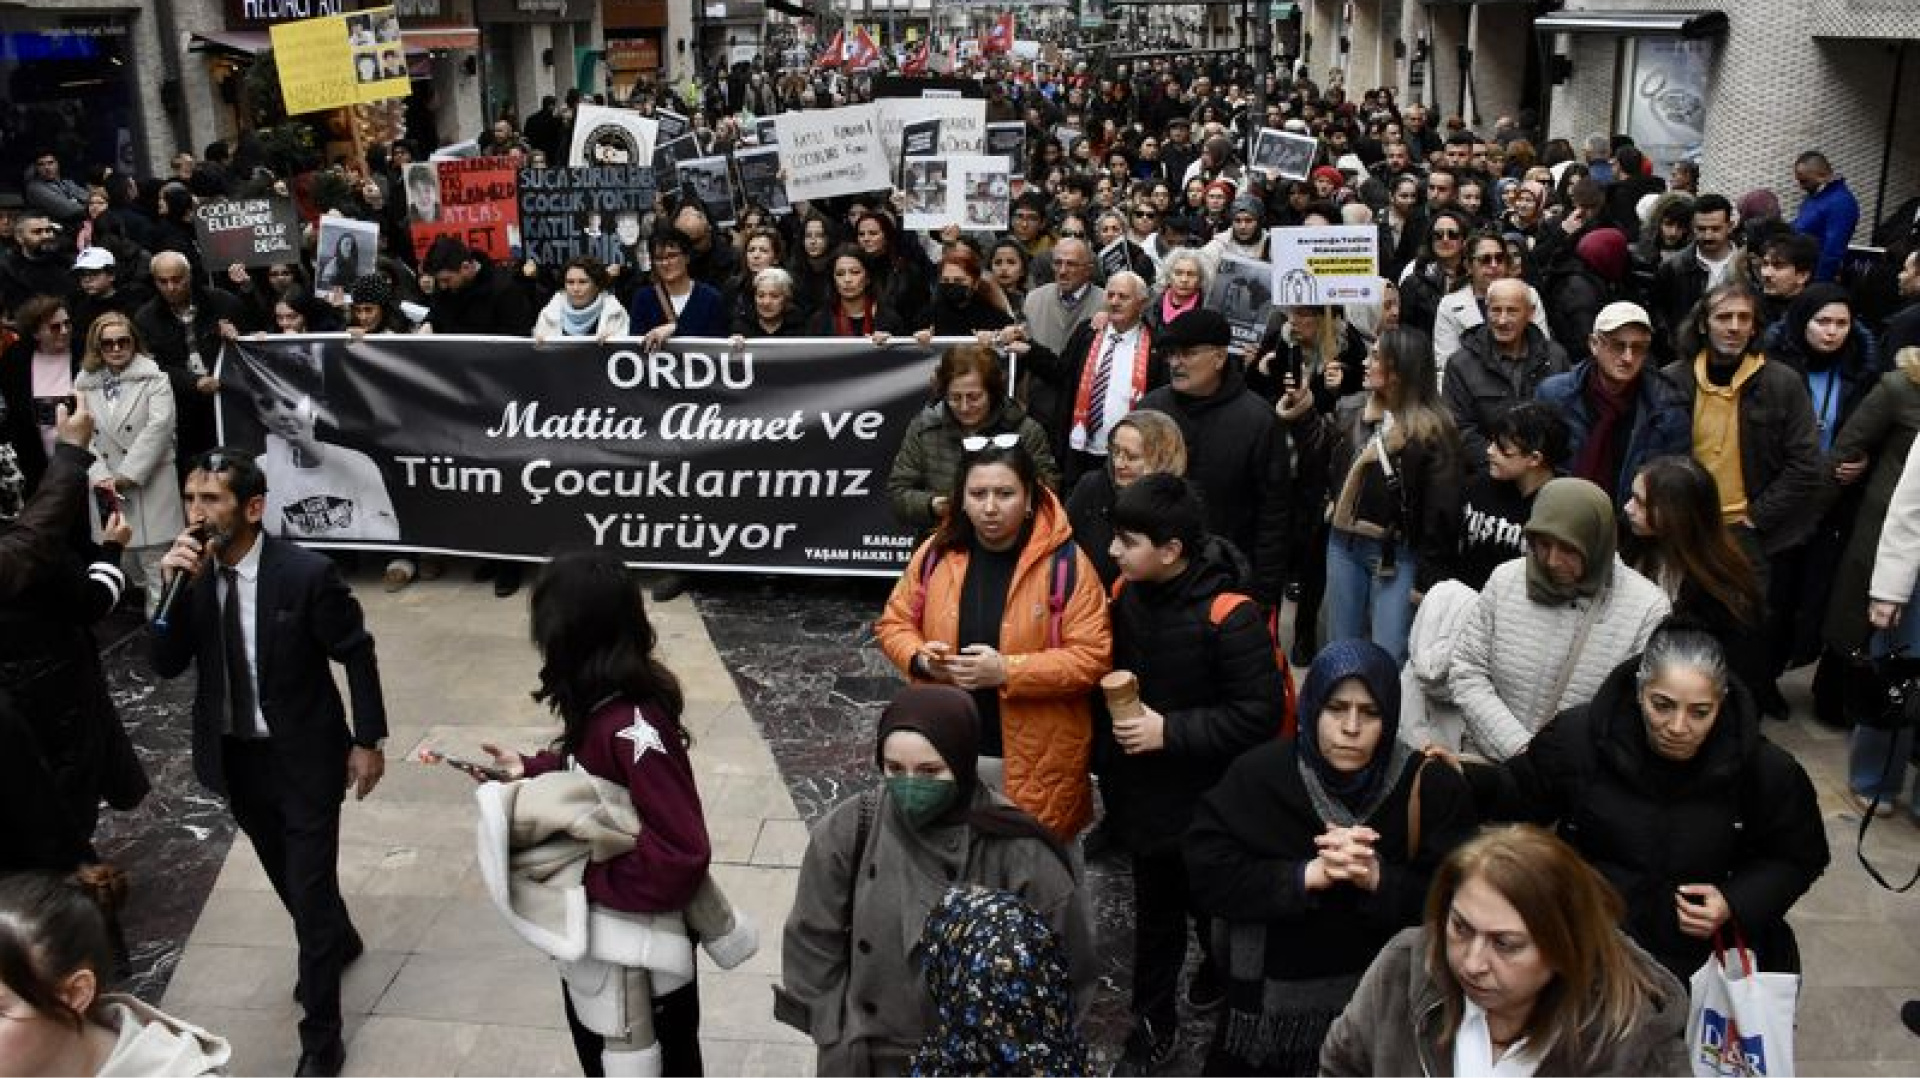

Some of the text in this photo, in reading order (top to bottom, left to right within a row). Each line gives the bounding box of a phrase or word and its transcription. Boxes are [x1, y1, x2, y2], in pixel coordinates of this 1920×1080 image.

[444, 202, 502, 224] ATLAS
[607, 352, 753, 389] ORDU
[486, 400, 884, 440] Mattia Ahmet ve
[394, 455, 871, 505] Tüm Çocuklarımız
[585, 513, 797, 557] Yürüyor
[804, 547, 912, 563] YAŞAM HAKKI SA
